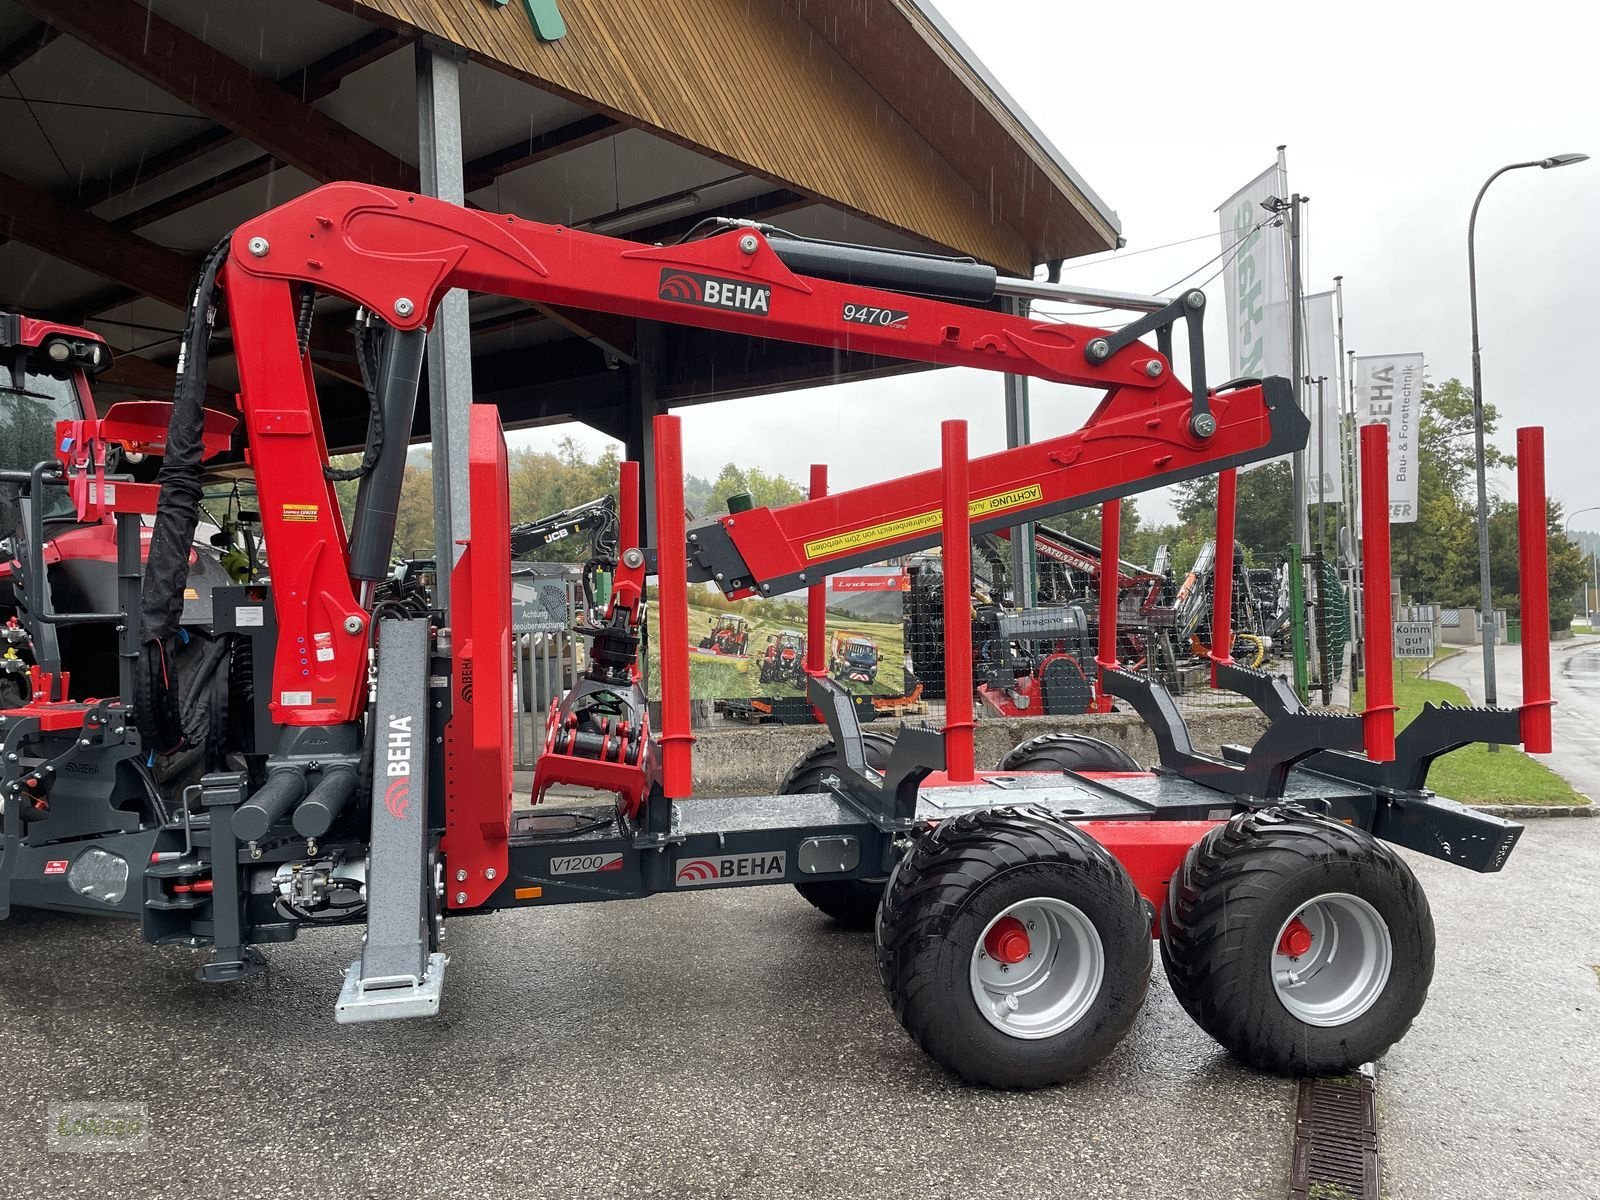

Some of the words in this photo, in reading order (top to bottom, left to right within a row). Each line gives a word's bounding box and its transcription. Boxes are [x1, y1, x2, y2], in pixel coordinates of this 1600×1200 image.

[843, 304, 892, 326] 9470
[1399, 364, 1414, 439] Forsttechnik
[1399, 442, 1408, 451] &
[1396, 455, 1407, 482] Bau-
[989, 489, 1037, 509] ACHTUNG!
[880, 514, 937, 535] Gefahrenbereich
[544, 528, 569, 543] JCB
[844, 532, 861, 542] 20m
[862, 529, 878, 537] von
[811, 538, 843, 552] verboten
[1040, 544, 1062, 560] PATU
[522, 610, 548, 620] Achtung
[512, 621, 565, 631] deoüberwachung
[1396, 625, 1430, 634] Komm
[1404, 637, 1422, 646] gut
[1398, 646, 1430, 655] heim!
[552, 856, 603, 873] V1200
